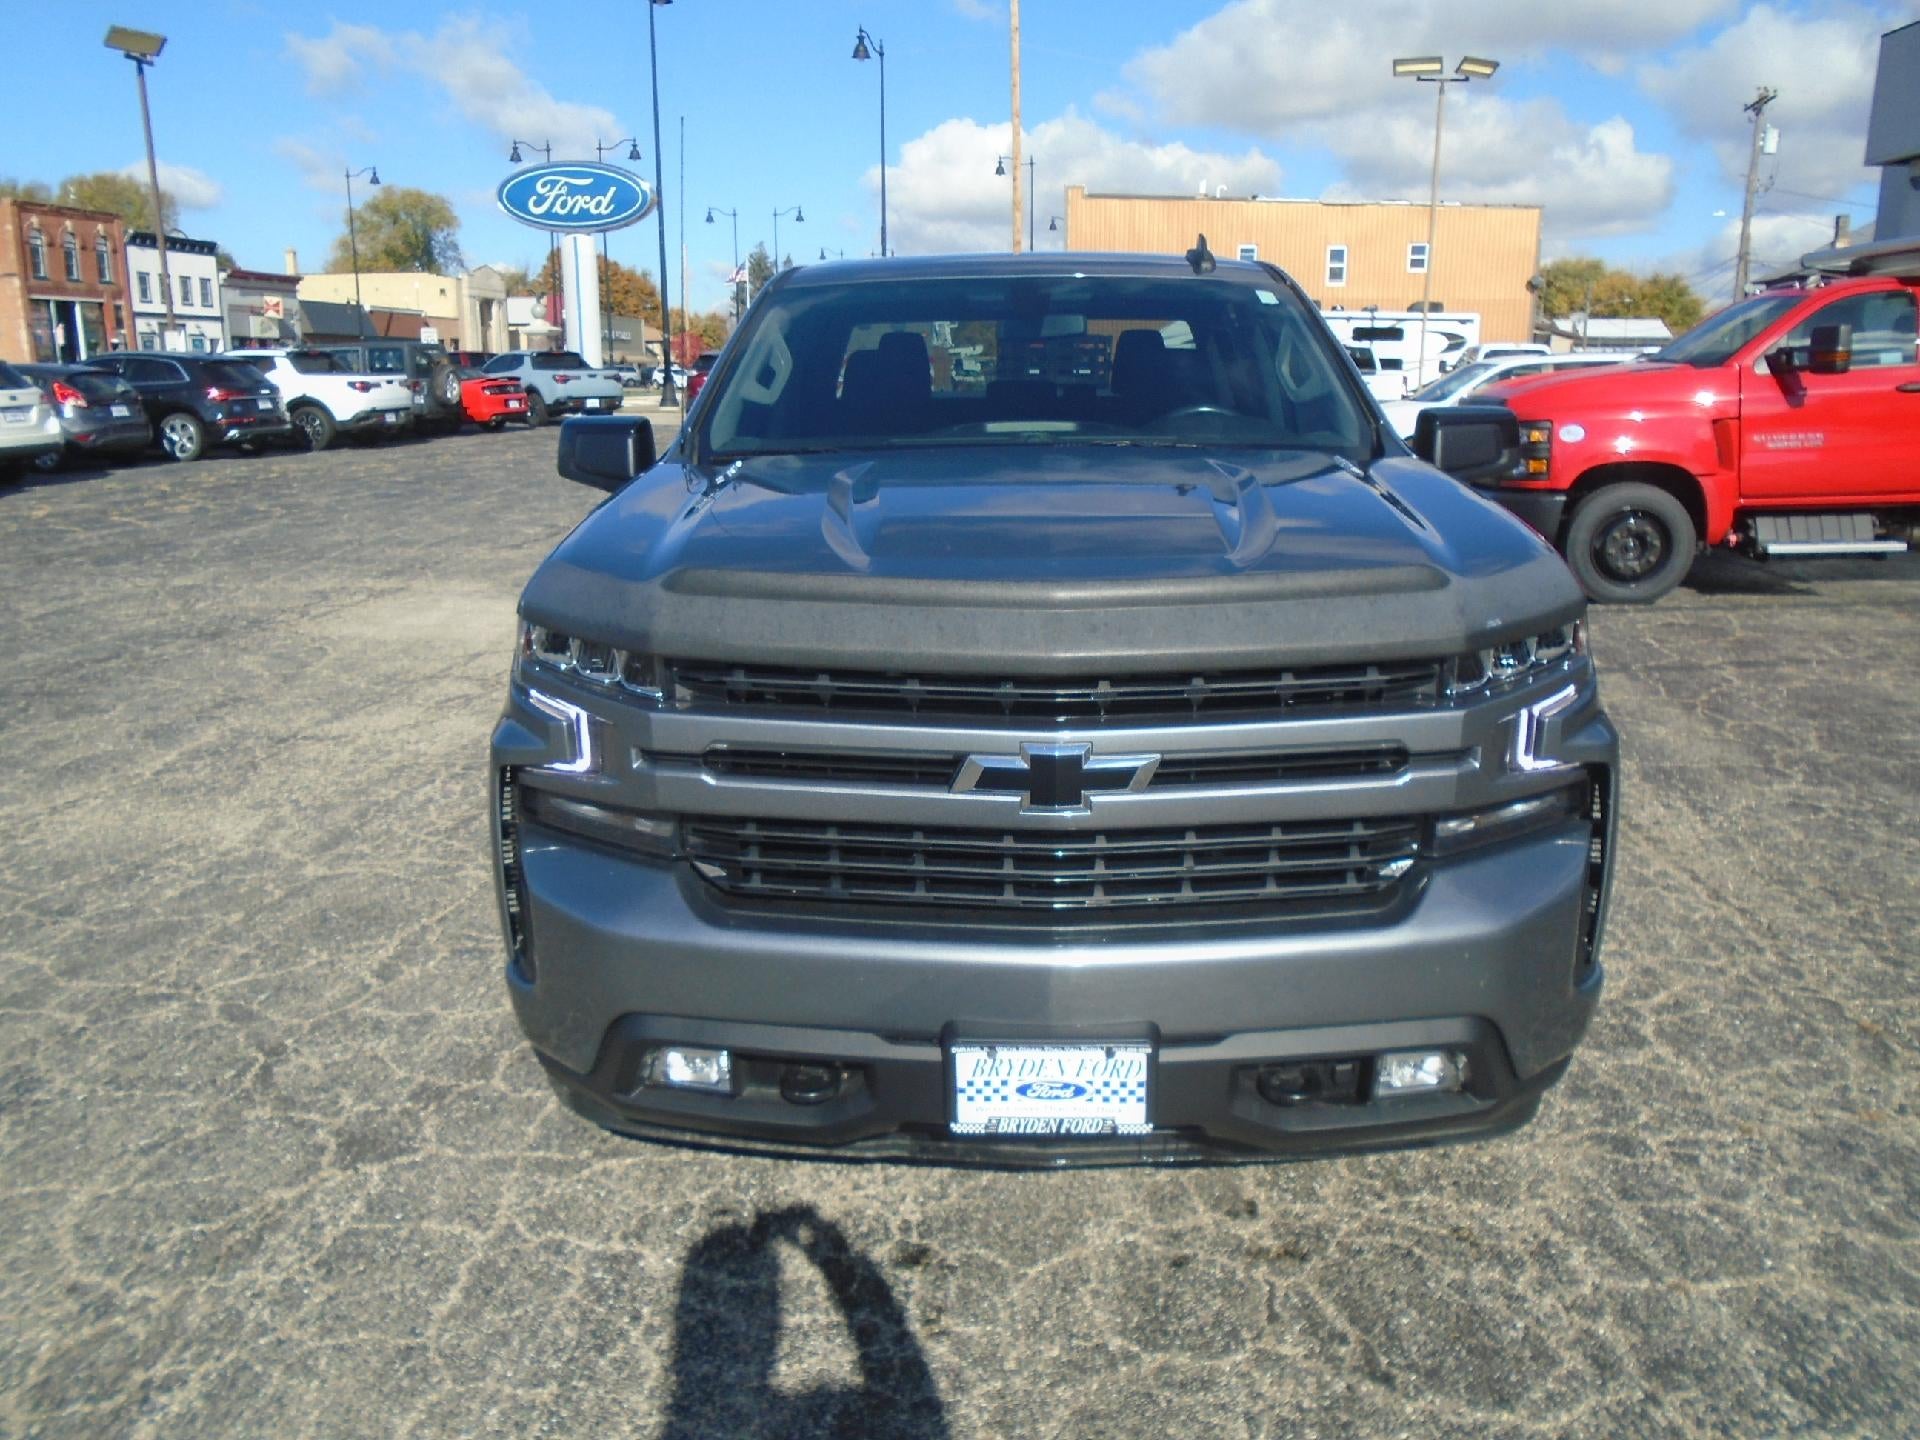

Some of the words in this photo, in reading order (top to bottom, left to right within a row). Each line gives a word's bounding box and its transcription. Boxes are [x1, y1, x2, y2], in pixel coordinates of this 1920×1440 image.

[528, 176, 616, 215] Ford
[972, 1058, 1066, 1078] BRYDEN
[1076, 1058, 1143, 1079] FORD
[1027, 1082, 1076, 1099] Ford
[998, 1118, 1058, 1134] BRYDEN
[1060, 1118, 1103, 1134] FORD
